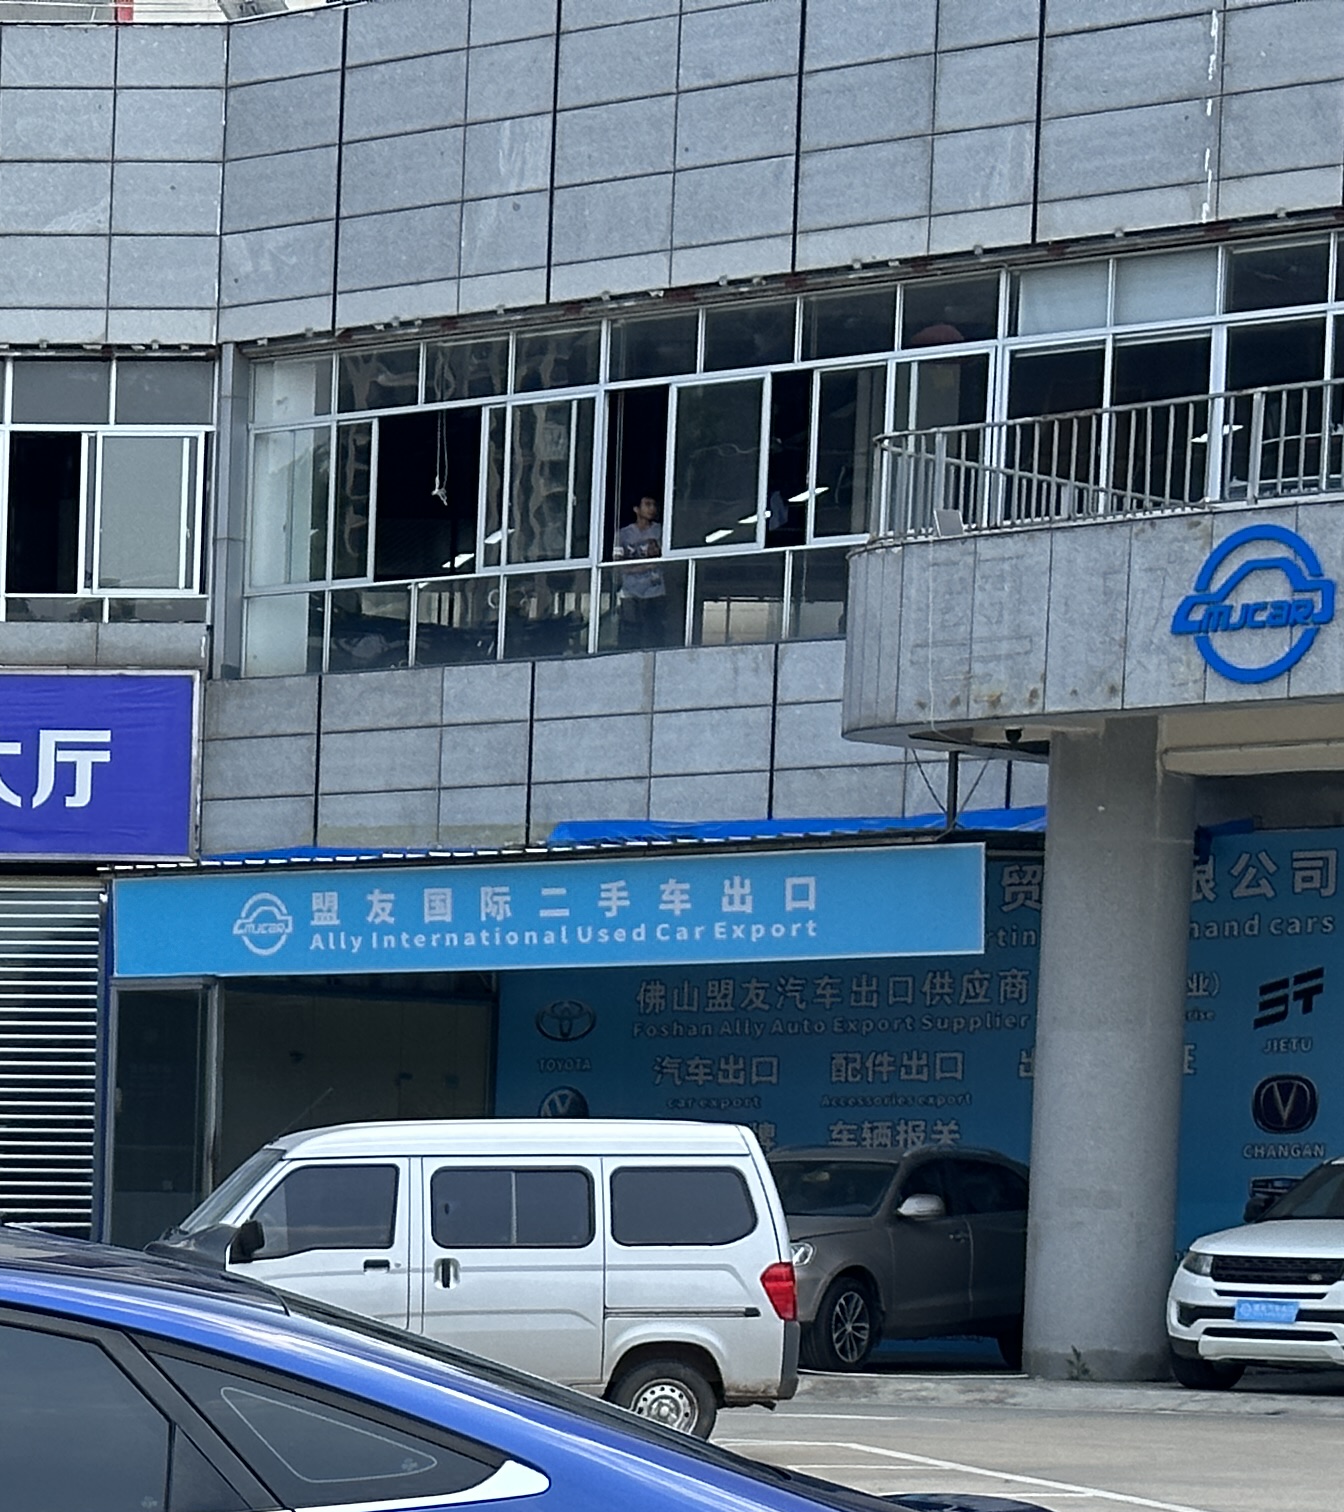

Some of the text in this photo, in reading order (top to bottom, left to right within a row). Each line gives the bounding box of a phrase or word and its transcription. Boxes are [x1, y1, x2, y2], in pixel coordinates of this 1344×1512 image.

[310, 875, 817, 926] 盟友国际二手车出口
[310, 920, 816, 953] Ally International Used Car Export
[1270, 917, 1333, 934] cars
[637, 969, 1030, 1013] 佛山盟友汽车出口供应商
[633, 1020, 713, 1038] Foshan
[719, 1018, 764, 1038] Ally
[771, 1017, 827, 1035] Auto
[834, 1014, 917, 1036] Export
[921, 1011, 1029, 1034] Supplier
[1263, 1036, 1312, 1053] JIETU
[538, 1058, 592, 1073] TOYOTA
[654, 1054, 778, 1086] 汽车出口
[831, 1051, 963, 1083] 配件出口
[1243, 1143, 1325, 1160] CHANGAN
